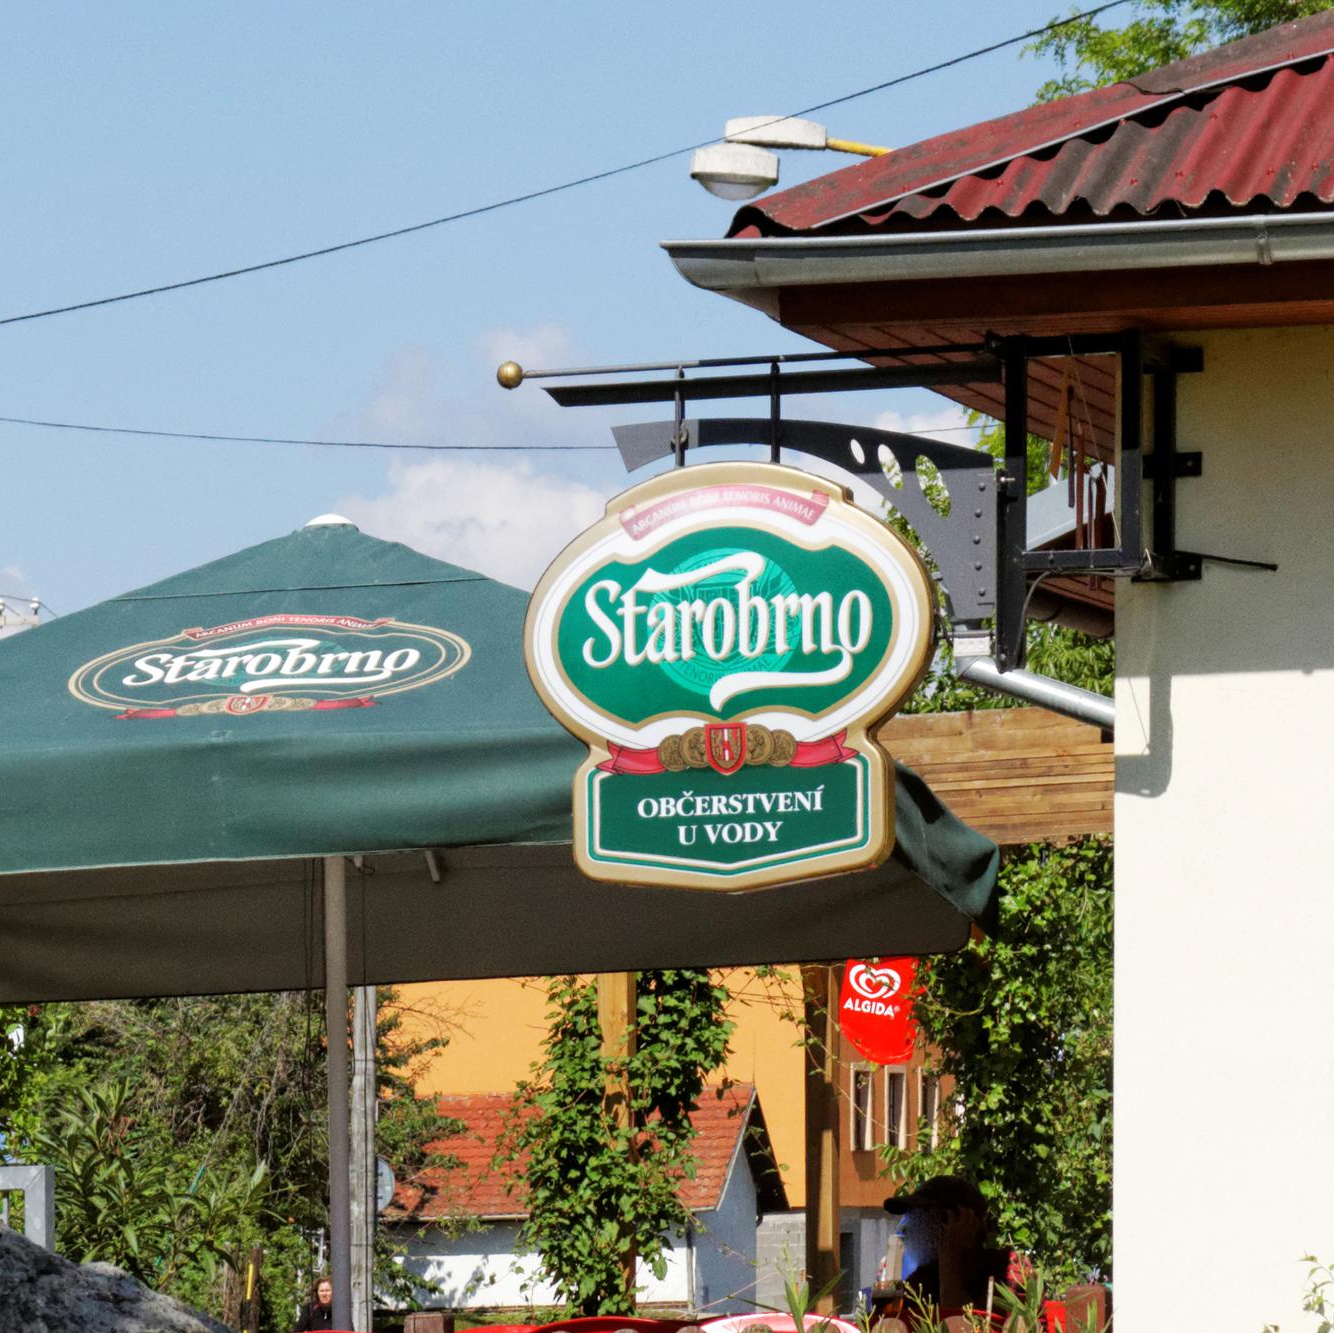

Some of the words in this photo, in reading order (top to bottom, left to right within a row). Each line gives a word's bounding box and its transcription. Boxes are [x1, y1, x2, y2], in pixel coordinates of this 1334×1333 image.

[582, 551, 874, 712] Starobrno
[122, 638, 420, 693] Starobrno
[636, 784, 826, 819] OBČERSTVENÍ
[677, 825, 696, 846] U
[704, 820, 784, 843] VODY
[843, 996, 895, 1018] ALGIDA
